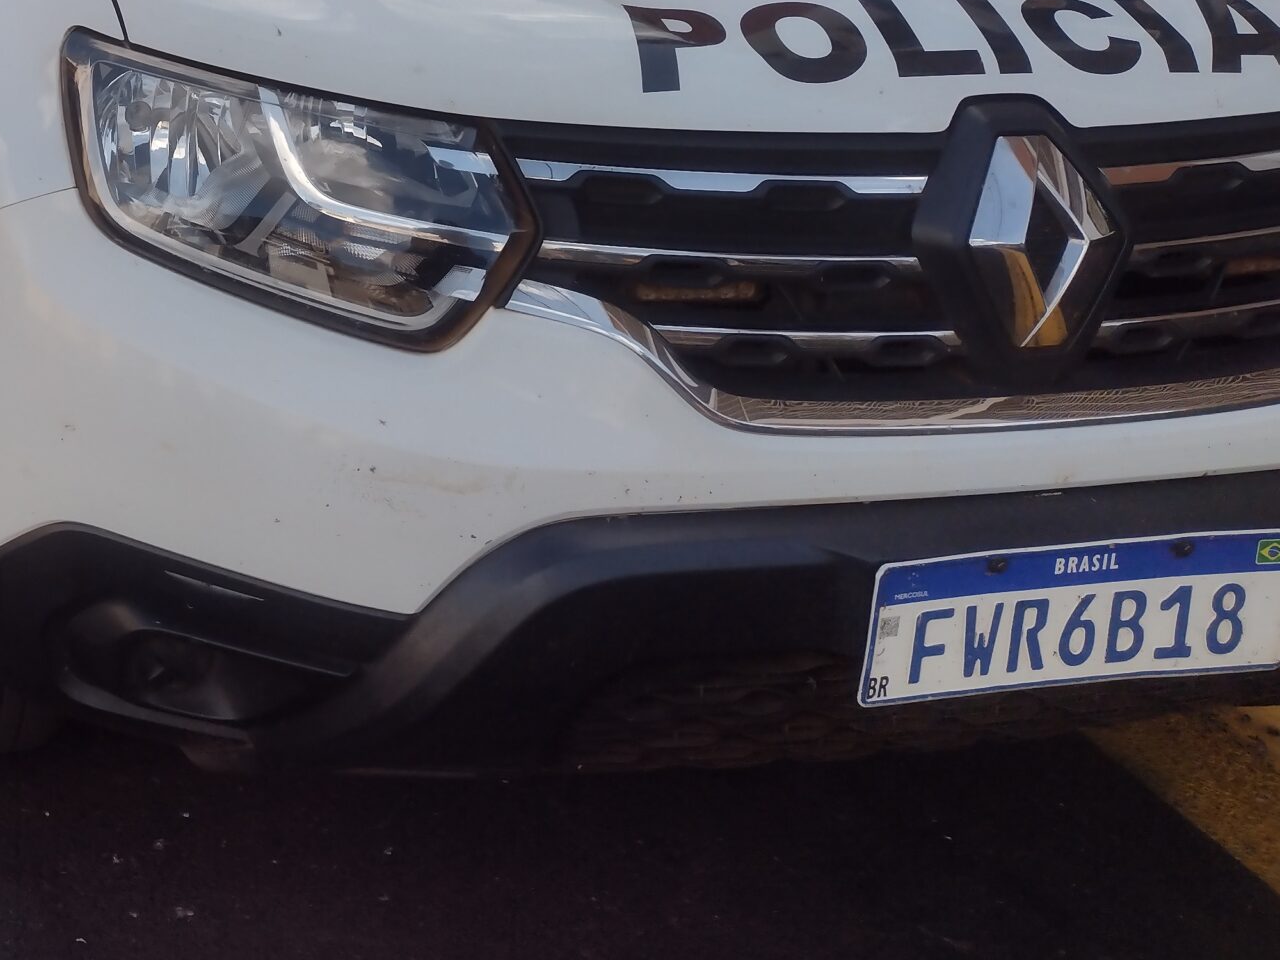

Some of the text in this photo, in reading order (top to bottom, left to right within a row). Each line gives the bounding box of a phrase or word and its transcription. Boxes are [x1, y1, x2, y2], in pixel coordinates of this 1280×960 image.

[1054, 553, 1119, 575] BRASIL
[908, 583, 1246, 685] FWR6B18
[867, 676, 889, 699] BR
